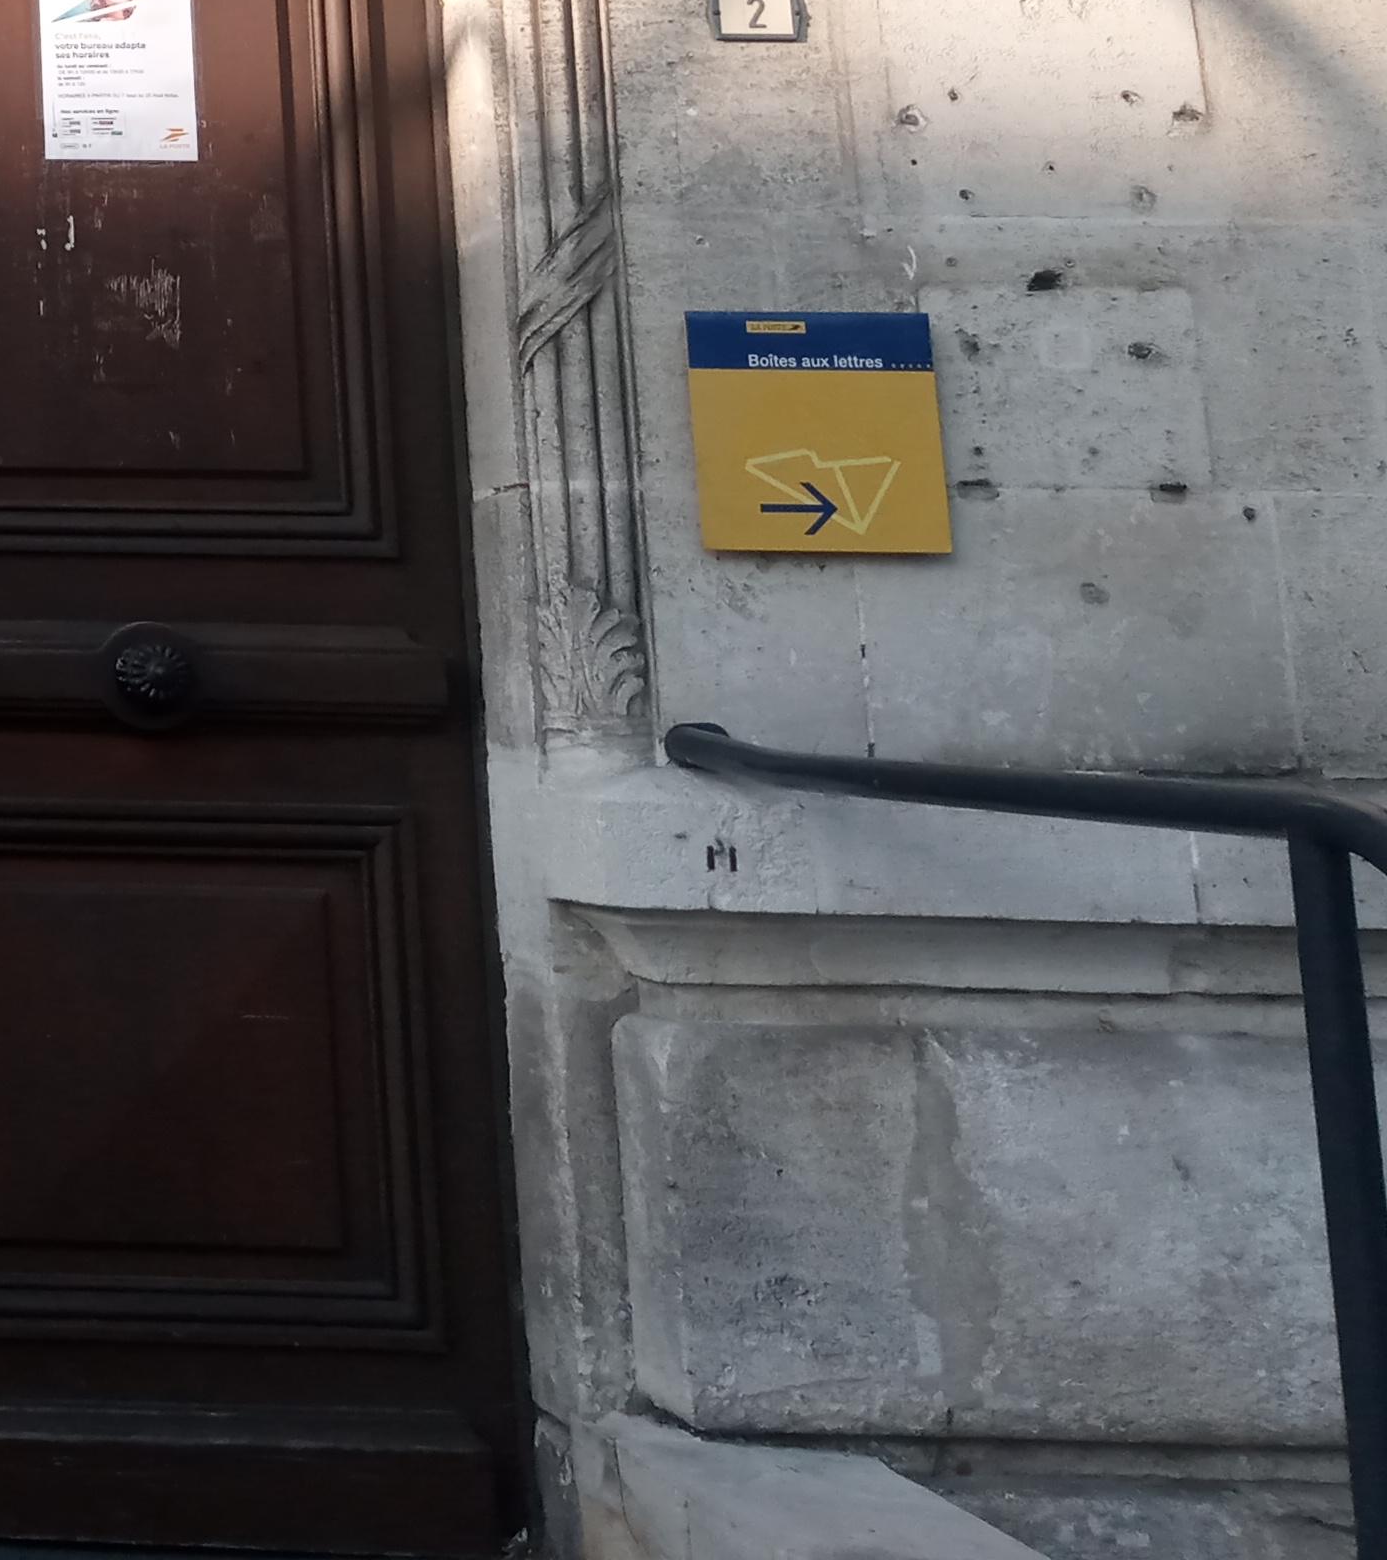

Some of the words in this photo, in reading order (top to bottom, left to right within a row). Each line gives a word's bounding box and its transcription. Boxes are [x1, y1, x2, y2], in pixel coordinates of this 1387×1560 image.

[748, 354, 797, 368] Boîtes
[801, 357, 830, 368] aux
[834, 355, 884, 368] lettres
